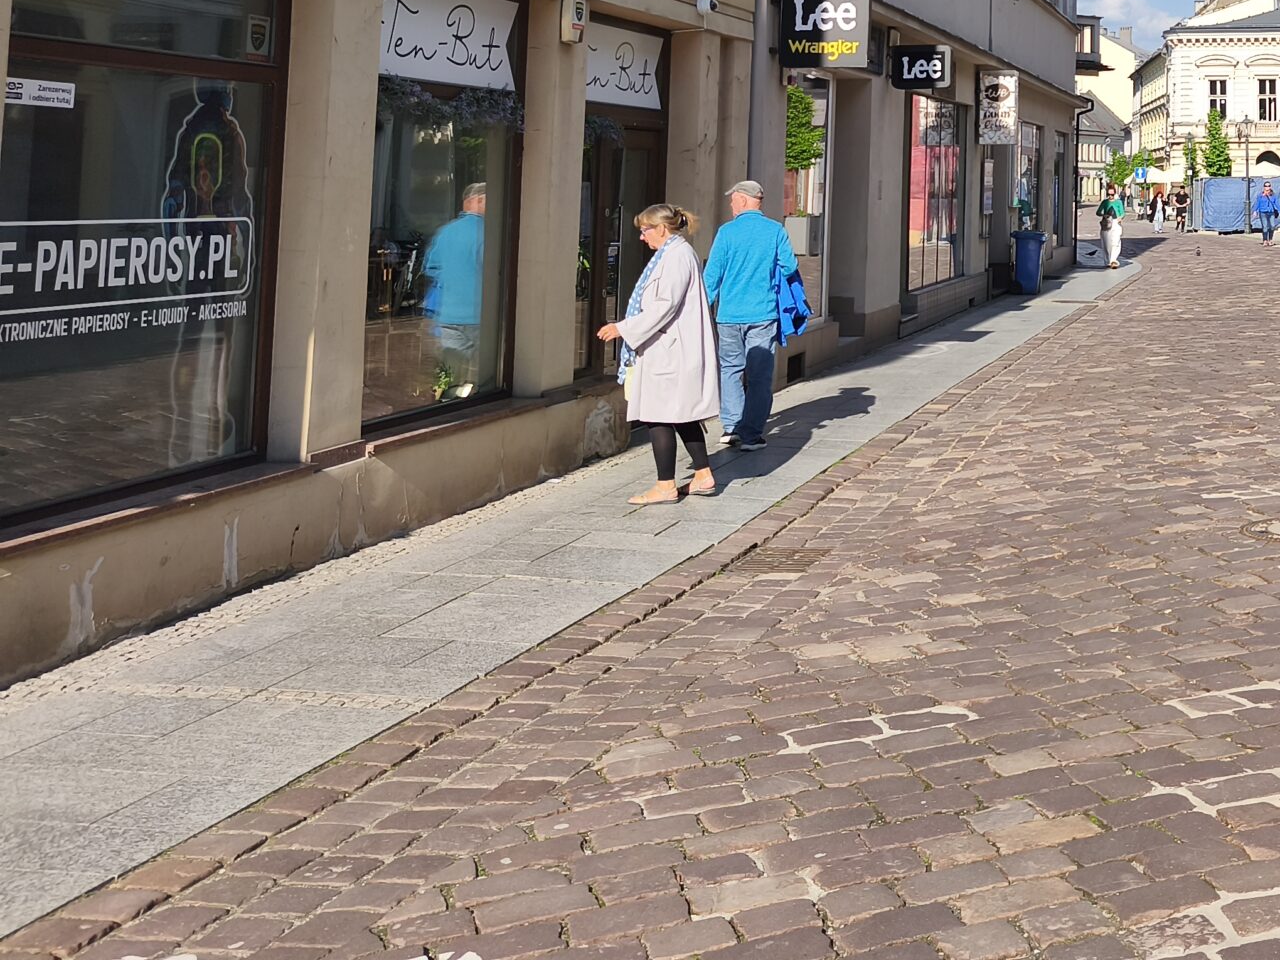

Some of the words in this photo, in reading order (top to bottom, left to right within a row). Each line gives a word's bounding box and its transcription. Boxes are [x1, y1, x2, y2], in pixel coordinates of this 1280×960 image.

[788, 39, 860, 61] Wrangler
[586, 42, 654, 94] n-But
[902, 55, 942, 79] Lee
[32, 95, 55, 103] odbierz
[56, 96, 71, 106] tutaj
[38, 84, 72, 95] Zarezerwuj
[0, 234, 238, 295] E-PAPIEROSY.PL
[71, 312, 131, 335] PAPIEROSY
[140, 306, 190, 328] E-LIQUIDY
[199, 300, 247, 321] AKCESORIA
